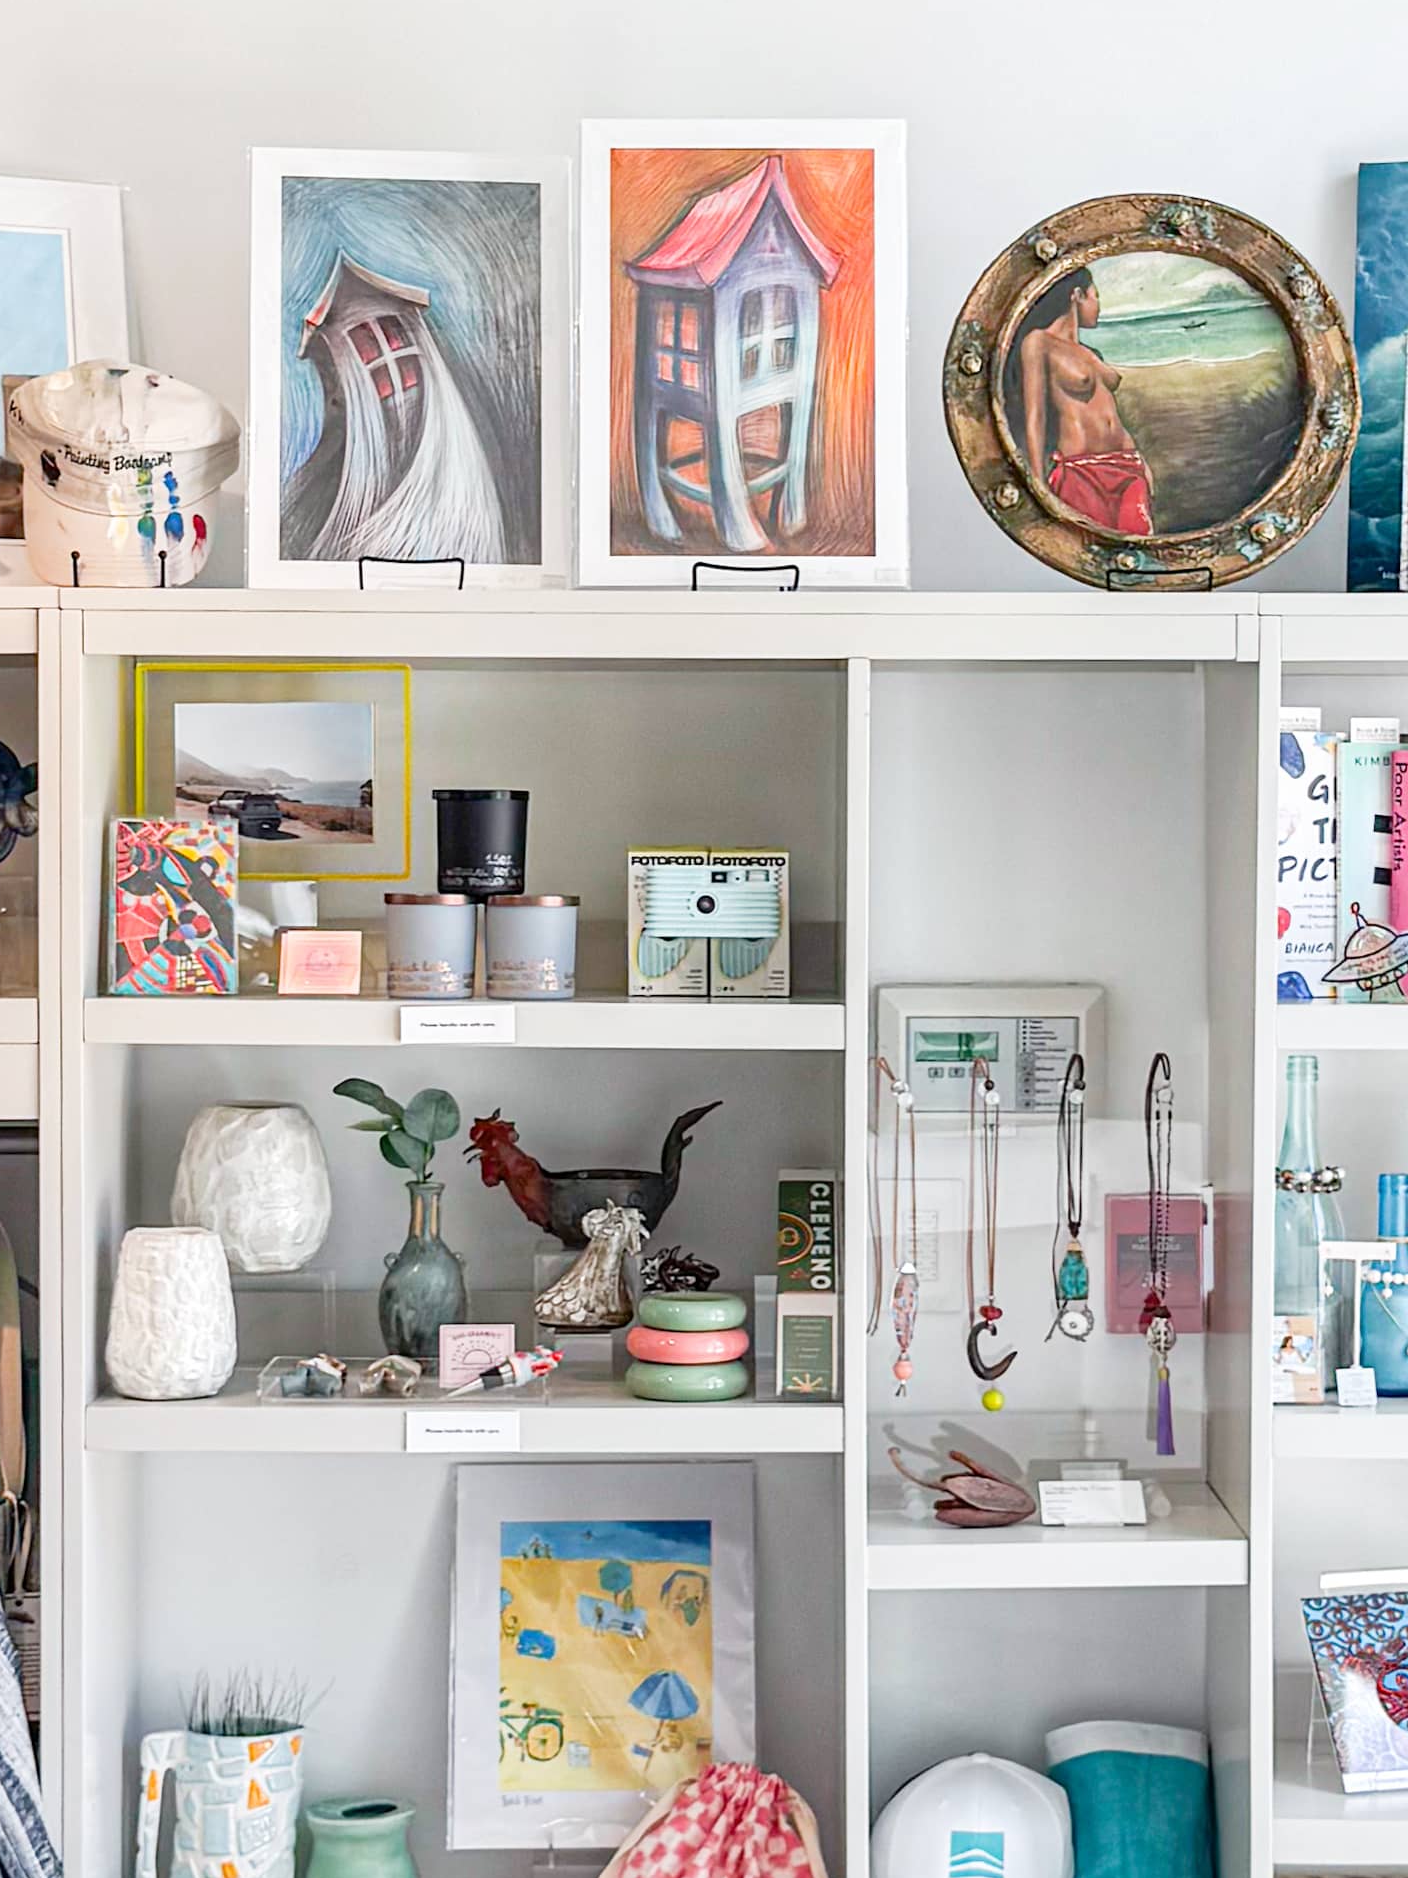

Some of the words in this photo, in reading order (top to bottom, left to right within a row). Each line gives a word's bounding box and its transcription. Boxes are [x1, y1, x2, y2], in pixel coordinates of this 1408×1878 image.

[1395, 762, 1408, 806] Poor
[1393, 813, 1405, 871] Artists
[631, 856, 704, 866] FOTOFOTO
[713, 857, 786, 867] FOTOFOTO
[1285, 942, 1334, 955] BIANCA
[809, 1183, 832, 1290] CLEMENO
